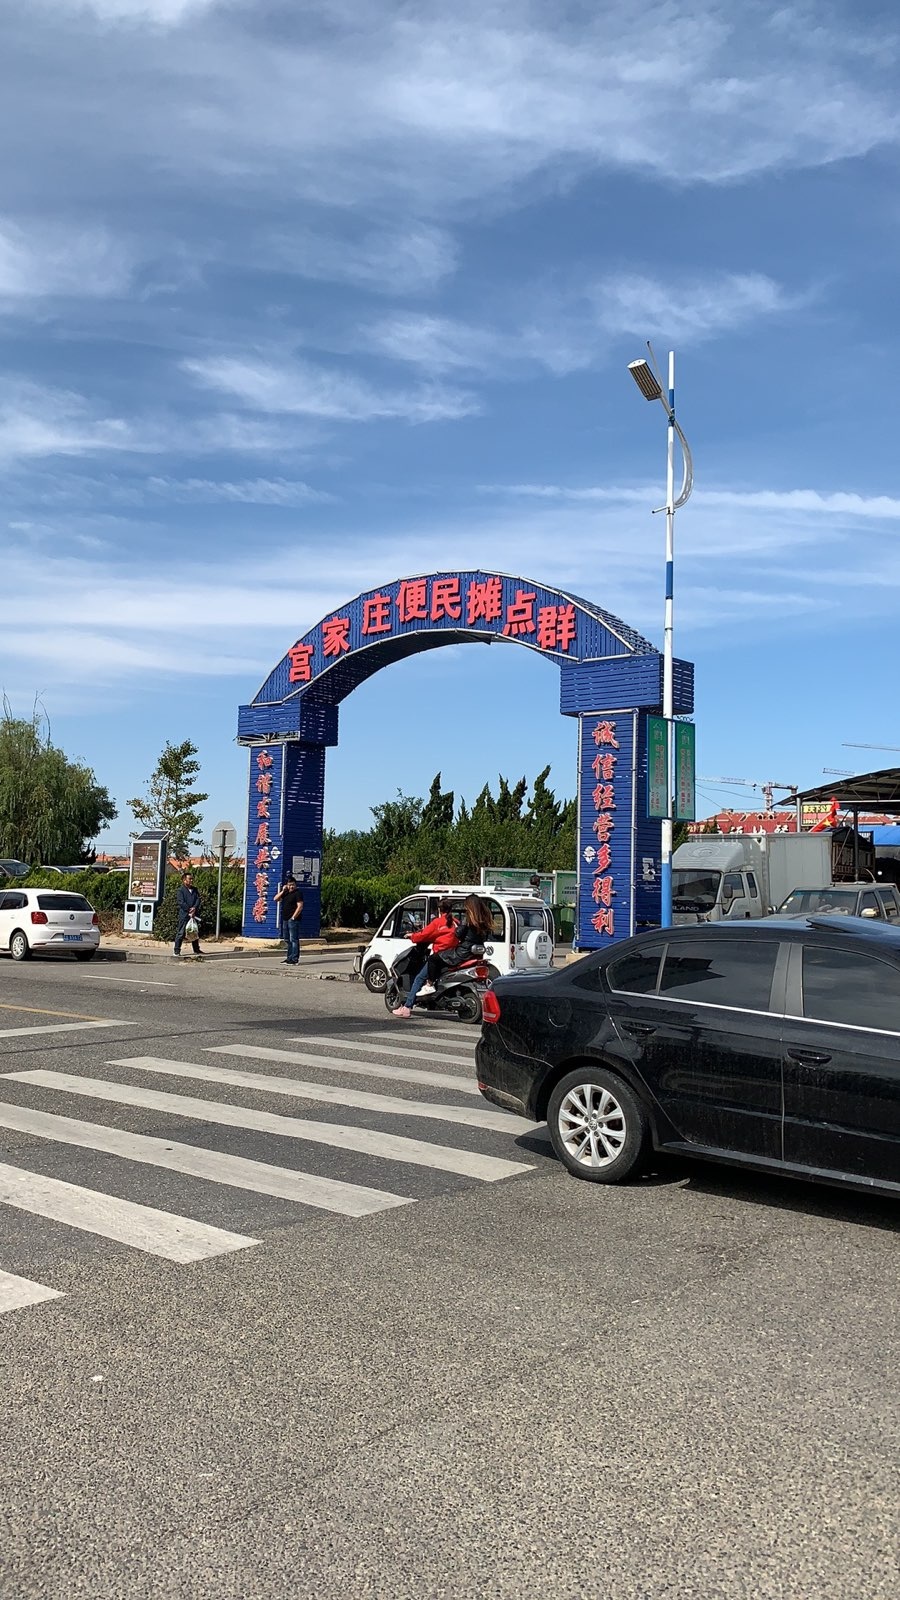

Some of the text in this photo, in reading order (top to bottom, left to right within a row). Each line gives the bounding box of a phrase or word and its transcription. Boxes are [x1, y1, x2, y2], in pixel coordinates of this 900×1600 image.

[288, 576, 577, 683] 宫家庄便民摊点群
[591, 720, 619, 937] 诚信经营多得利
